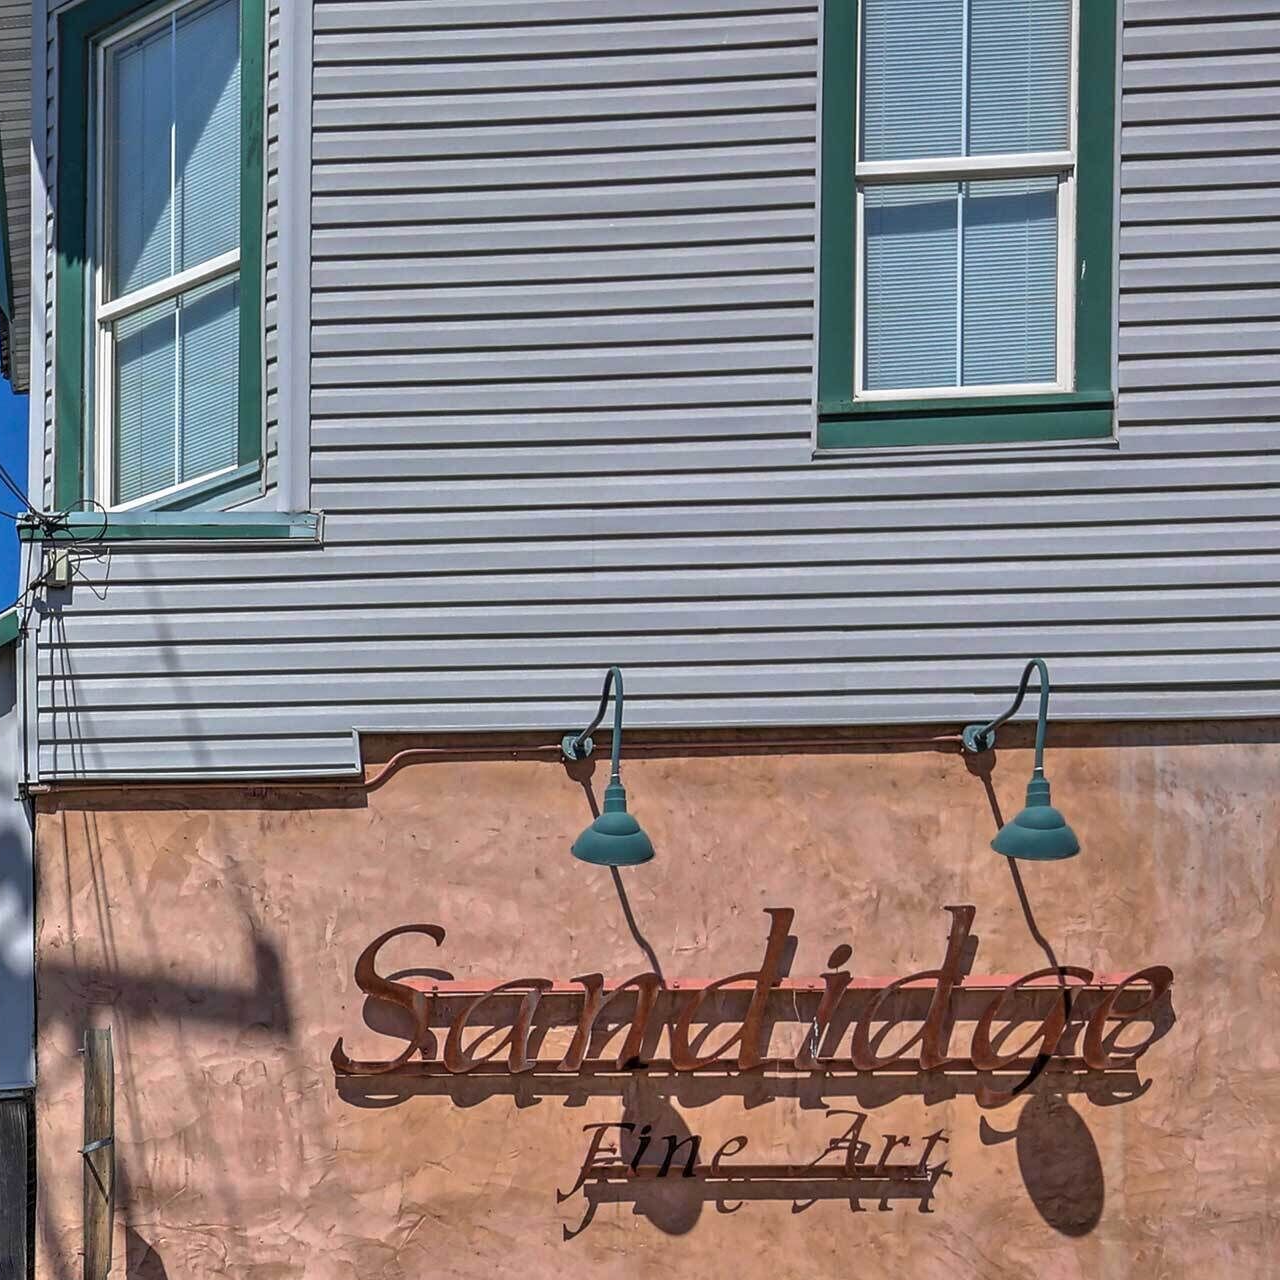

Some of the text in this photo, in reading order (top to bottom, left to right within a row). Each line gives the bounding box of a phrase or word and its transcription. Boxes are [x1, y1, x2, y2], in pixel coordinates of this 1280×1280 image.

[332, 905, 1175, 1105] Sandidge
[558, 1109, 949, 1203] Fine Art
